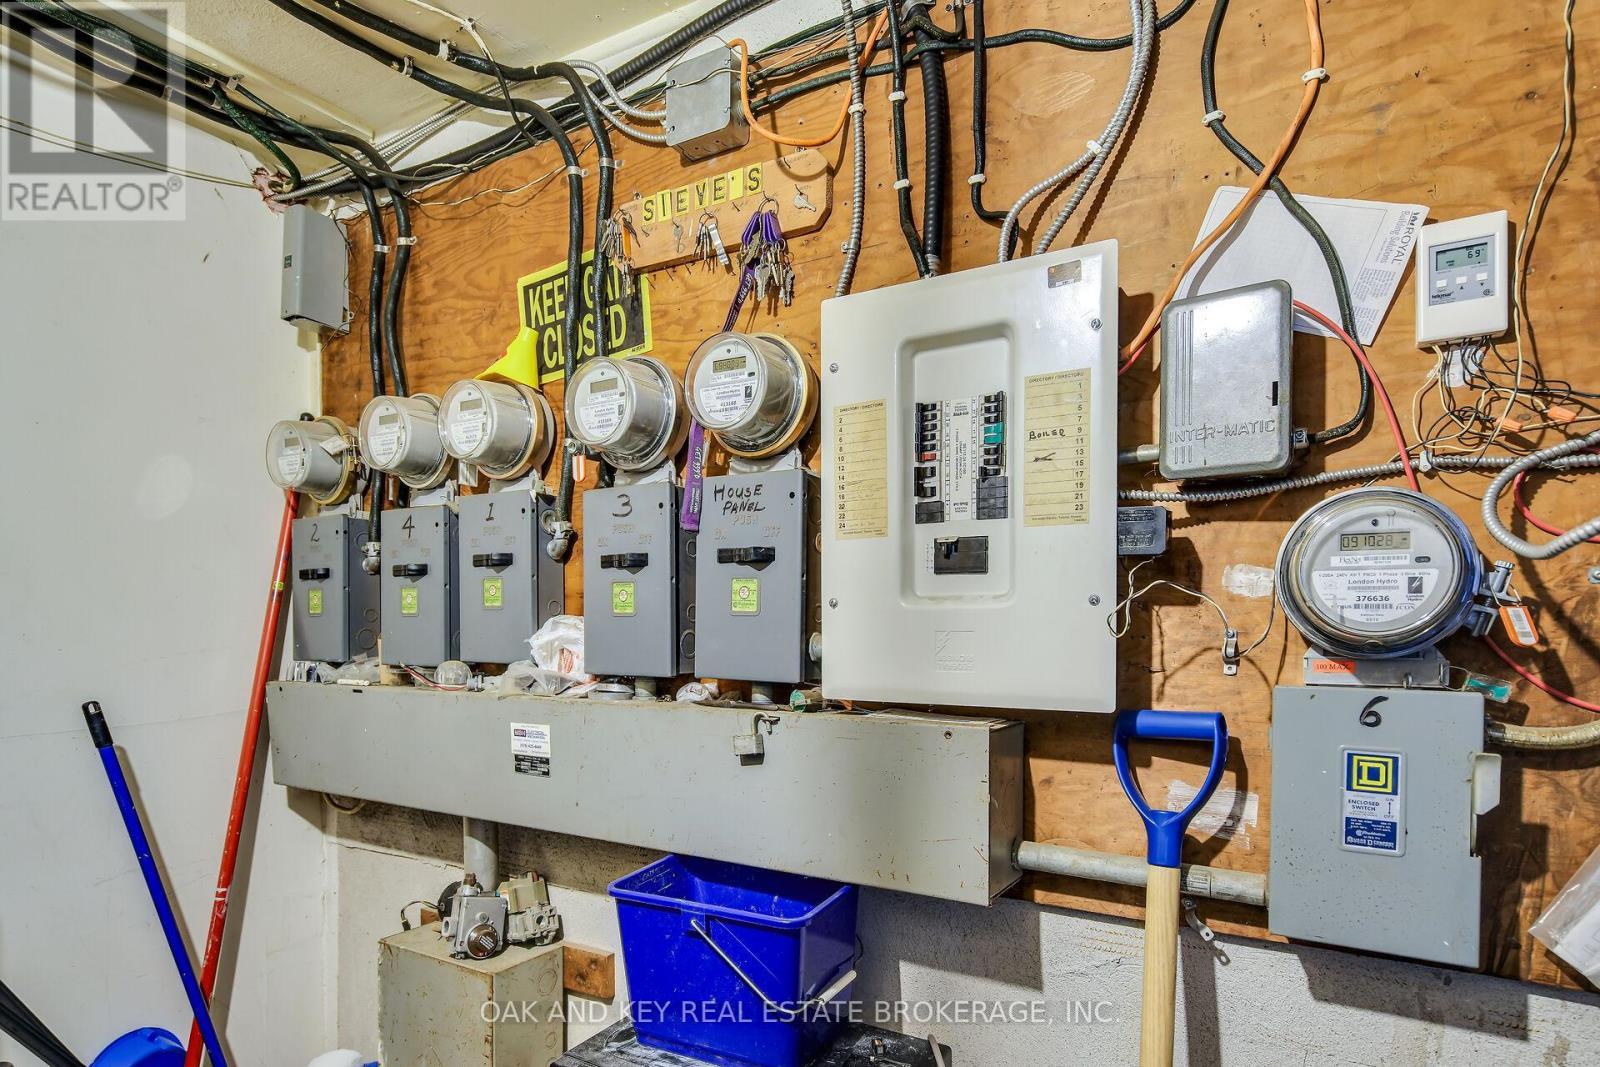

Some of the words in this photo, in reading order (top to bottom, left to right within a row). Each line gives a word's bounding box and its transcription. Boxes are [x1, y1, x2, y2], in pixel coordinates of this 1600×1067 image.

[1391, 227, 1414, 265] ROYAL
[1028, 428, 1066, 441] BOILER
[1169, 419, 1276, 444] INTER-MATIC
[714, 484, 763, 502] HOUSE
[485, 502, 494, 522] 1
[612, 494, 632, 517] 3
[722, 499, 766, 516] PANEL
[310, 523, 320, 542] 2
[402, 514, 416, 539] 4
[1342, 534, 1392, 548] 091028
[1360, 696, 1389, 728] 6
[1348, 798, 1380, 808] ENCLOSED
